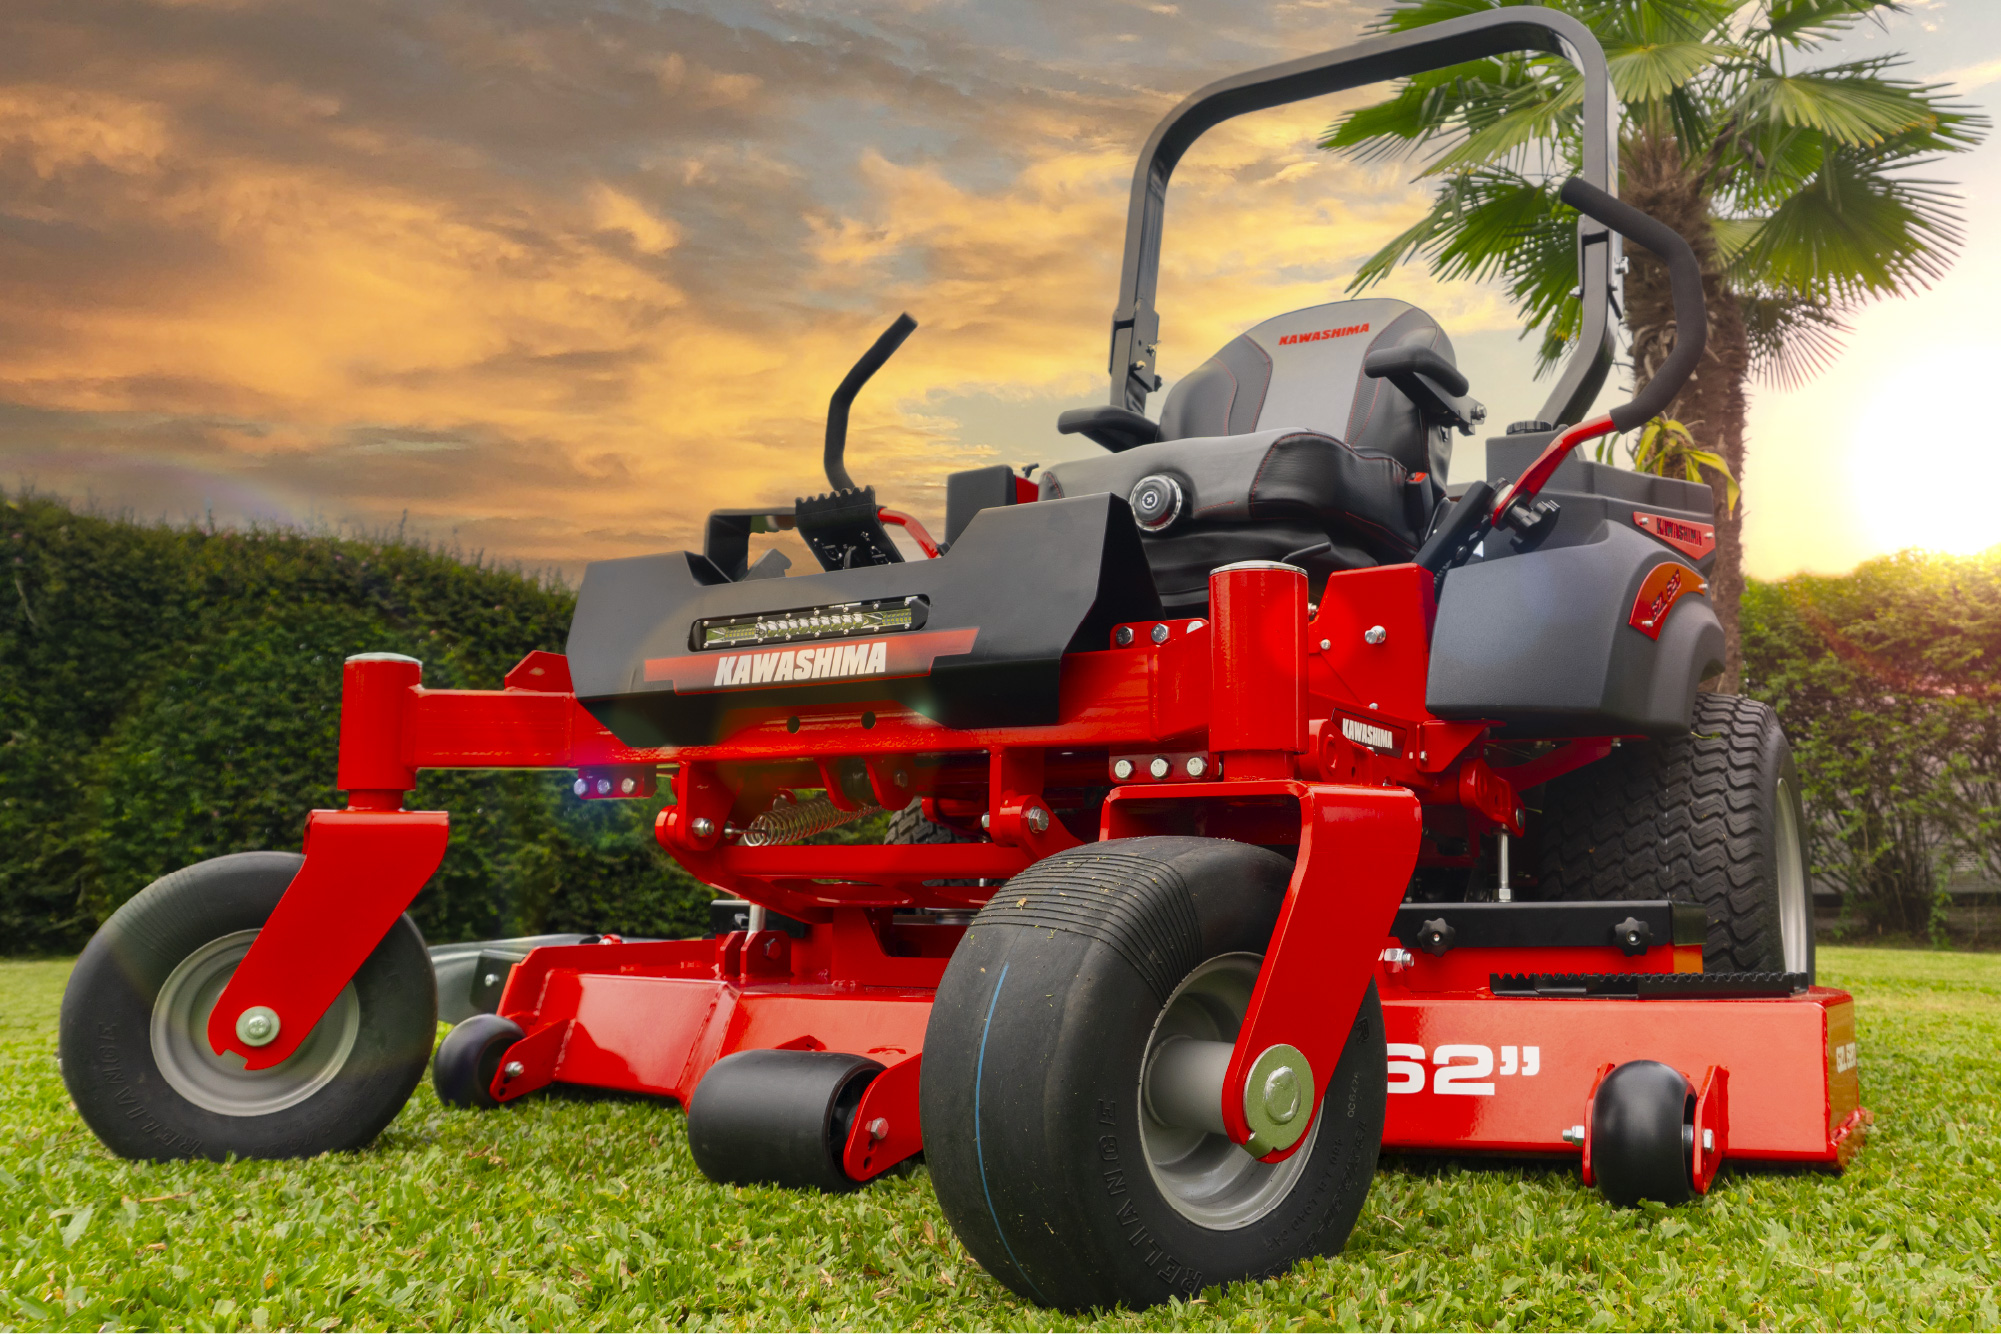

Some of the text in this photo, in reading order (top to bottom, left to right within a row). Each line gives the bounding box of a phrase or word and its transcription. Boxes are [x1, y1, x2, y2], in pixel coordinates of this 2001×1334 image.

[1278, 322, 1370, 346] KAWASHIMA
[1656, 517, 1703, 548] KAWASHIMA
[713, 641, 887, 687] KAWASHIMA
[1342, 717, 1393, 750] KAWASHIMA
[97, 1021, 203, 1156] RELIANCE
[1097, 1098, 1203, 1295] RELIANCE
